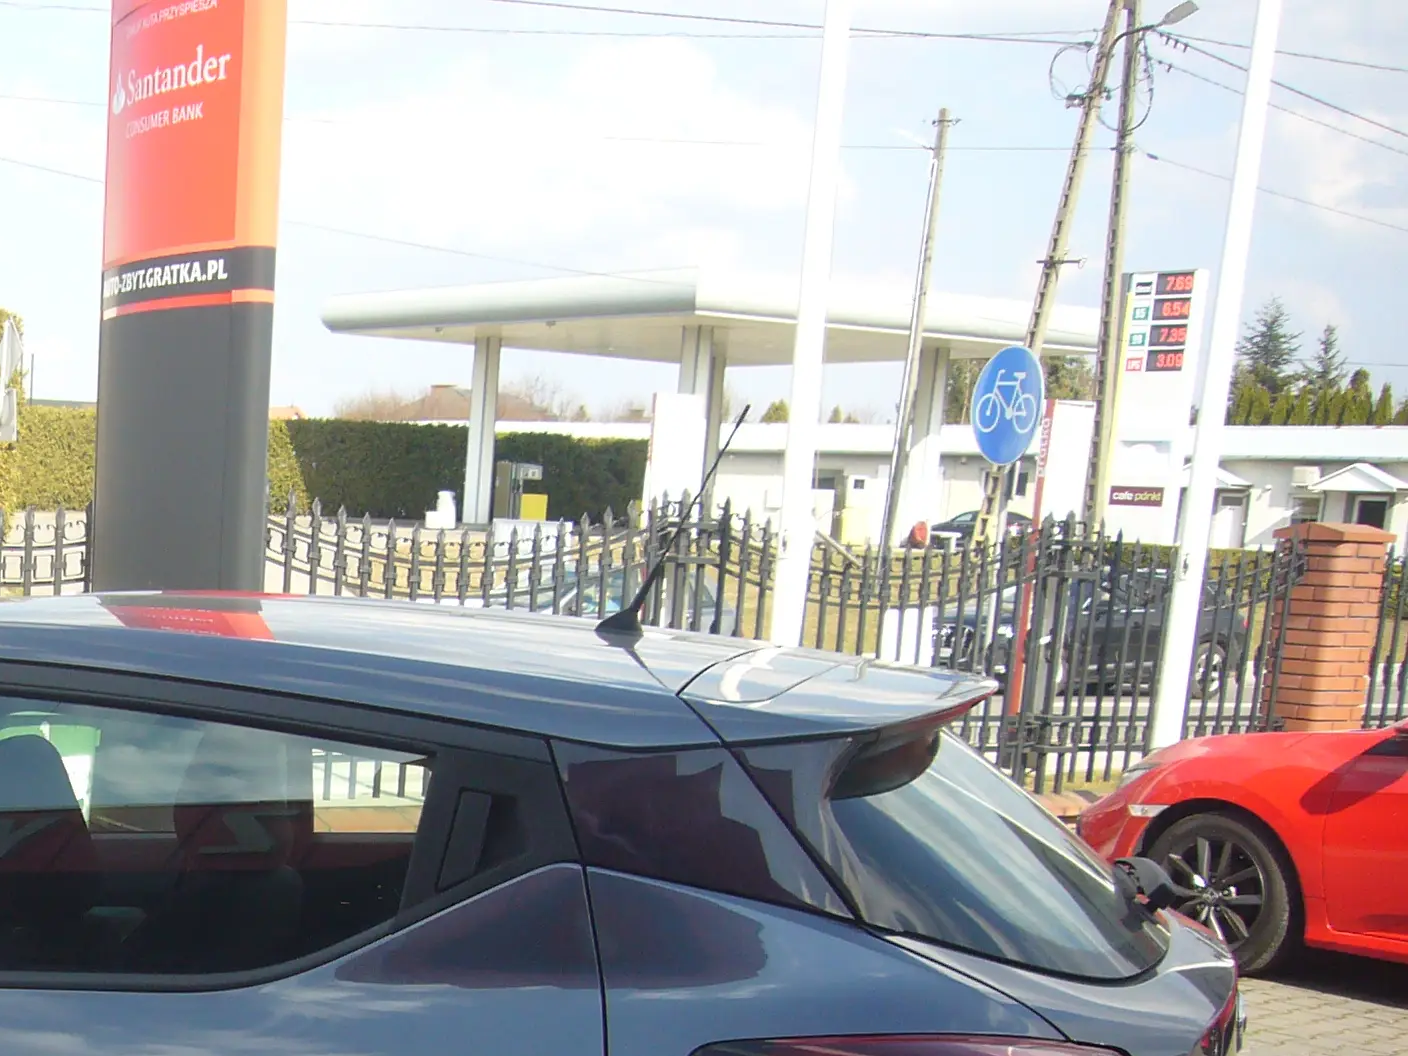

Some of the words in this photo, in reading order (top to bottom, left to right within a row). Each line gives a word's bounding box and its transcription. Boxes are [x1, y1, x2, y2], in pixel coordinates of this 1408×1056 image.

[127, 44, 231, 106] Santander
[125, 110, 170, 139] CONSUMER
[172, 101, 204, 124] BANK
